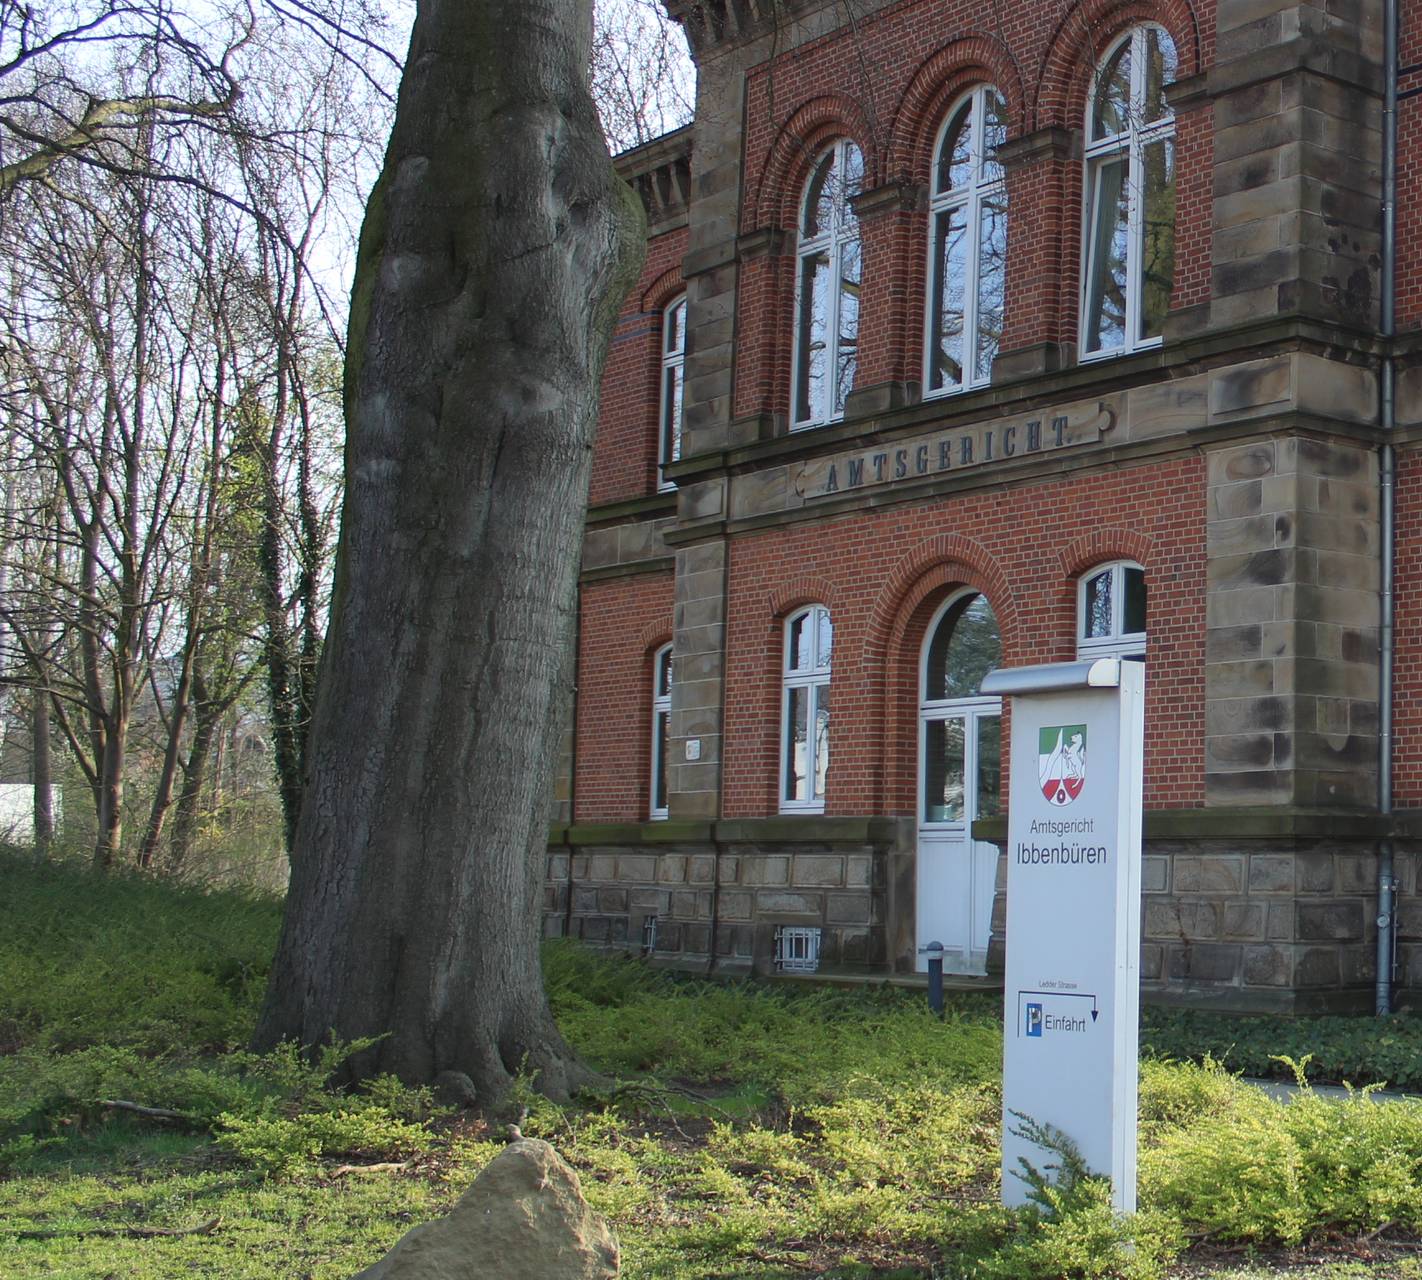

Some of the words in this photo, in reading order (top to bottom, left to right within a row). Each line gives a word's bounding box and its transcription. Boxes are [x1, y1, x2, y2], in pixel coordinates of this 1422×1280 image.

[826, 415, 1069, 493] AMTSGERICHT
[1030, 819, 1094, 837] Amtsgericht
[1017, 842, 1107, 864] Ibbenbüren
[1045, 1014, 1086, 1032] Einfahrt
